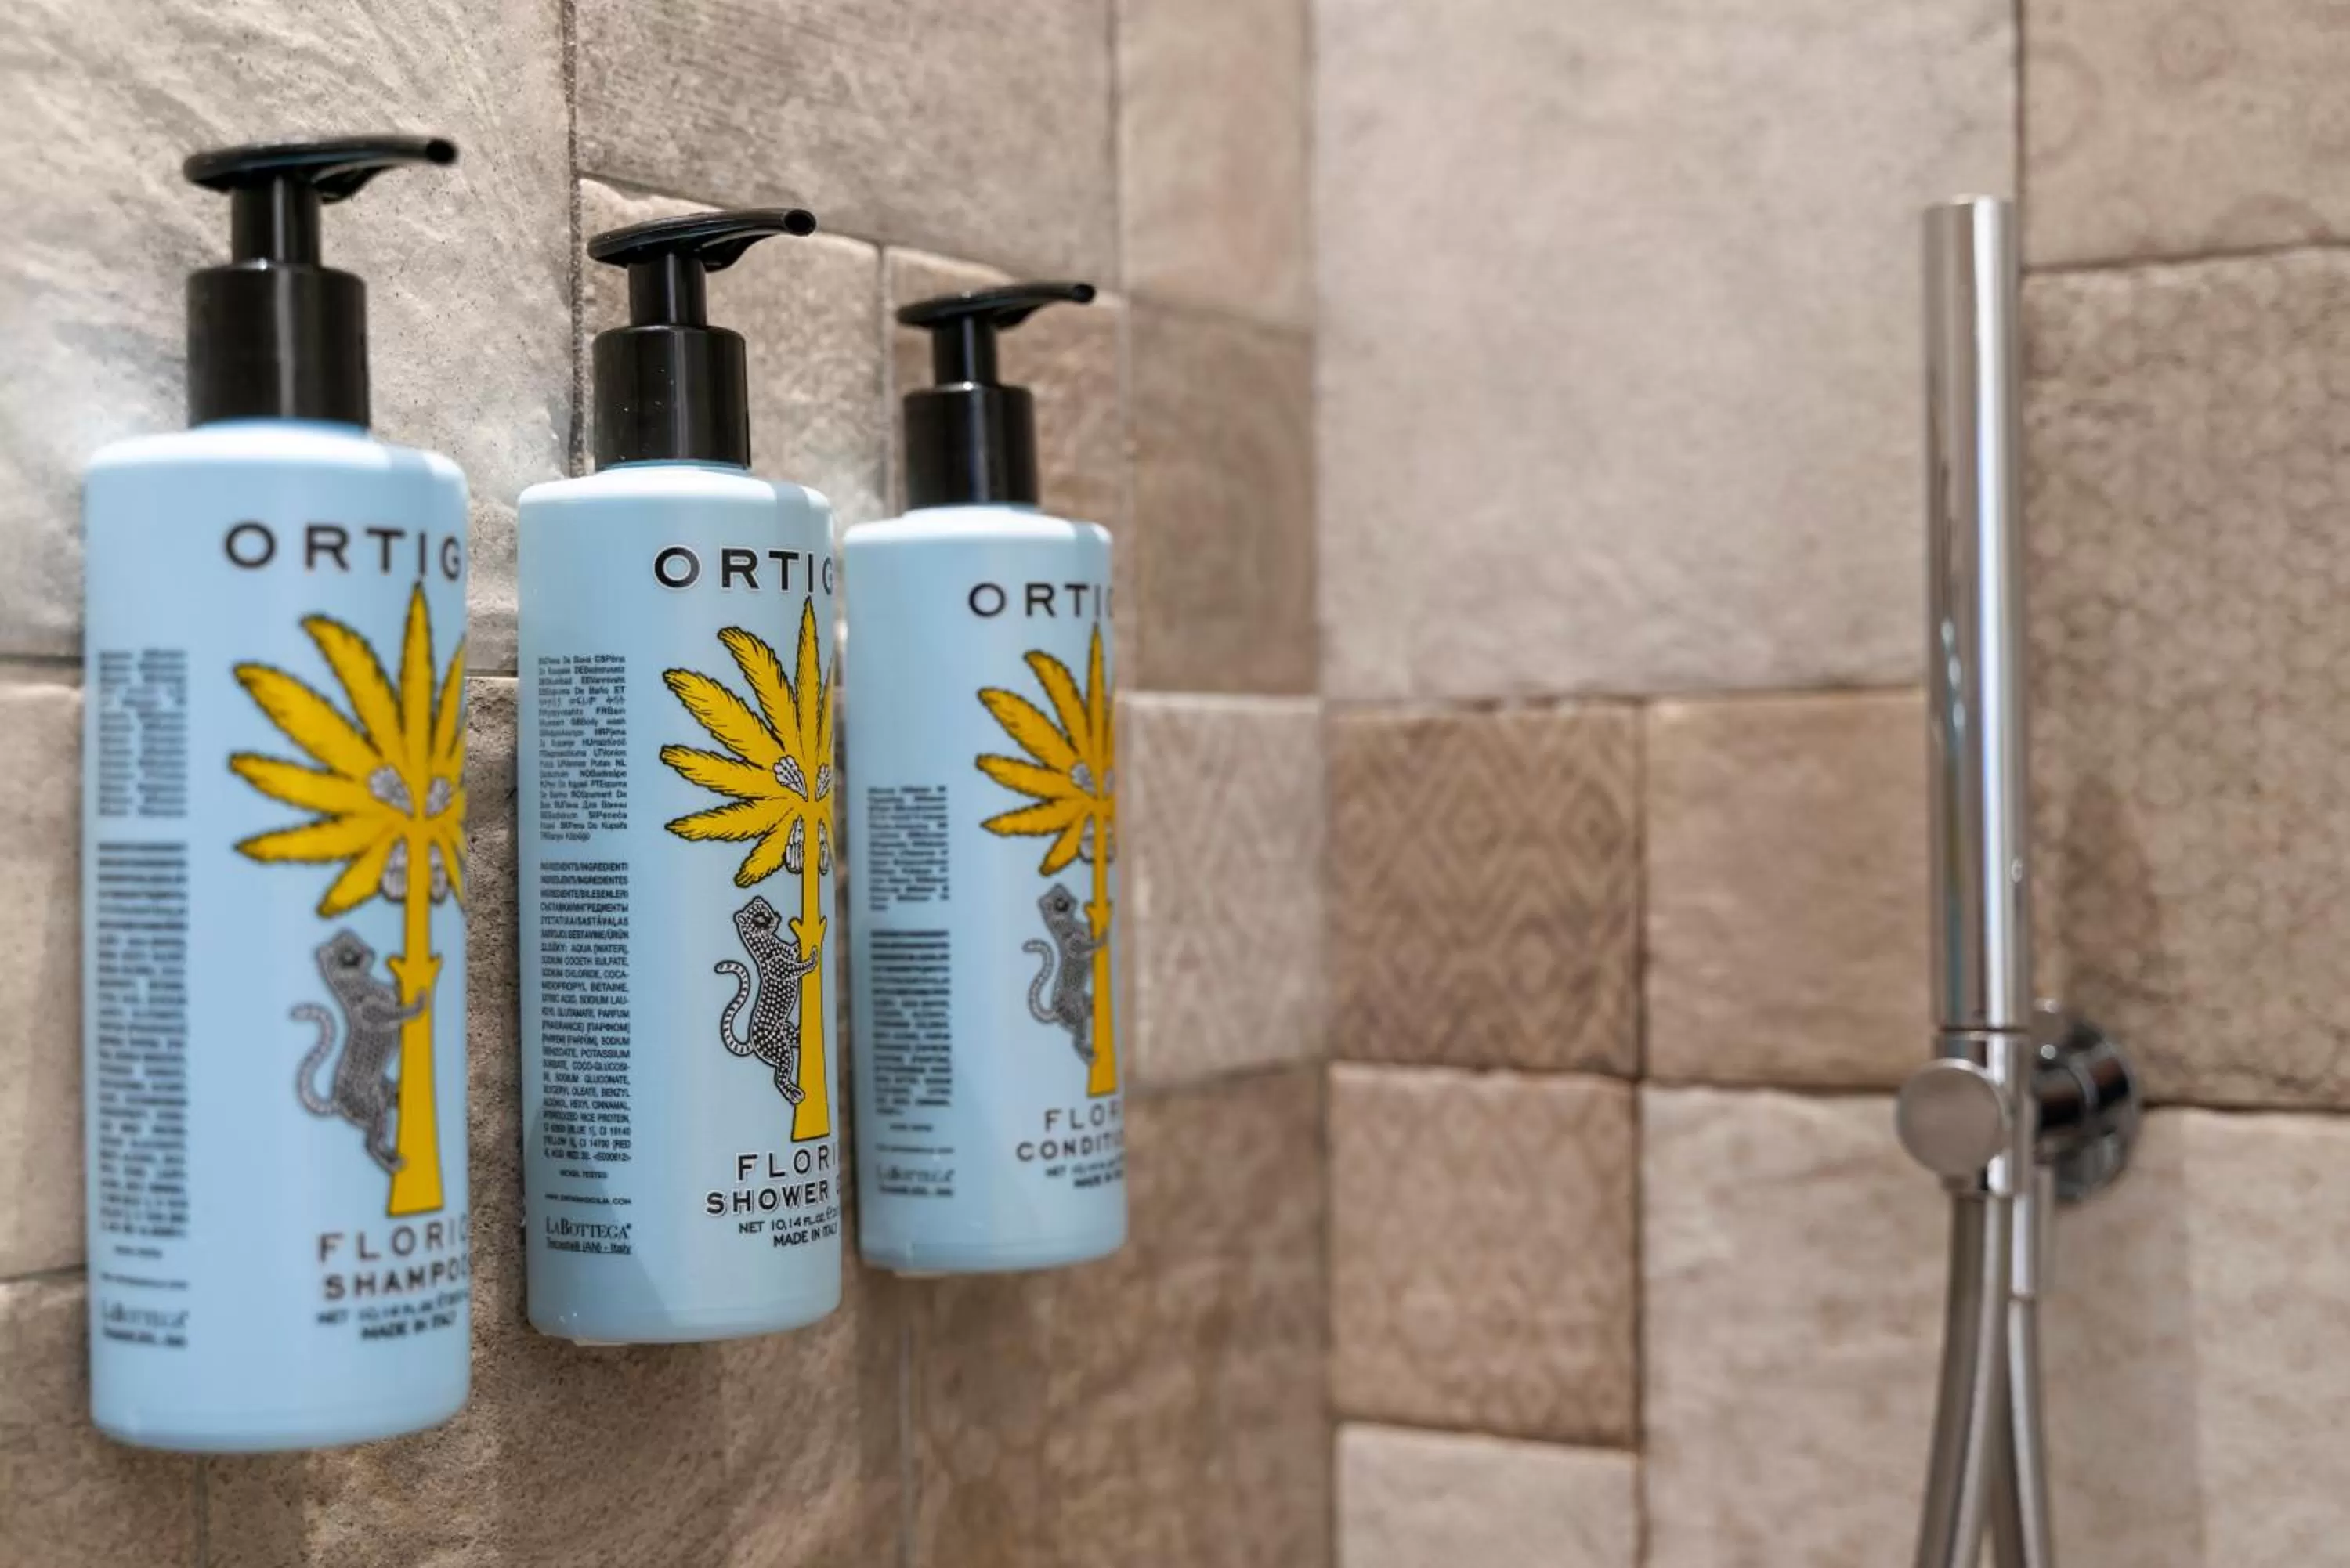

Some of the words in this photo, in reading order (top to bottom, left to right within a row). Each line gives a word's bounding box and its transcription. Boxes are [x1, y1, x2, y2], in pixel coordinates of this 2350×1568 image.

[225, 520, 462, 581] ORTIG
[653, 547, 834, 596] ORTIG
[707, 1180, 828, 1215] SHOWER
[739, 1220, 765, 1234] NET
[773, 1230, 809, 1248] MADE
[812, 1227, 821, 1241] IN
